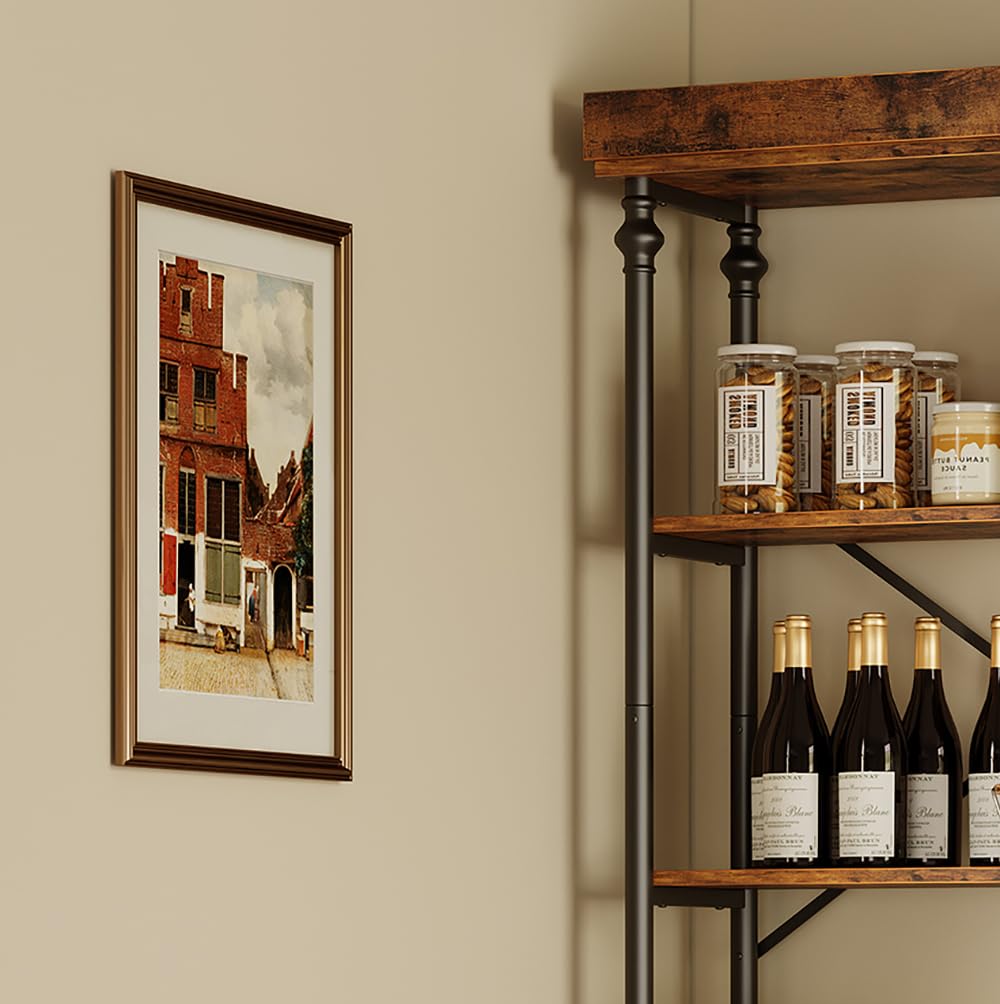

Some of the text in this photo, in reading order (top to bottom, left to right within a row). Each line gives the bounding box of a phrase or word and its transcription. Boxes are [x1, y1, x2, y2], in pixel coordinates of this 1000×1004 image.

[785, 805, 814, 817] Blanc
[862, 804, 890, 816] Blanc
[914, 806, 944, 818] Blanc
